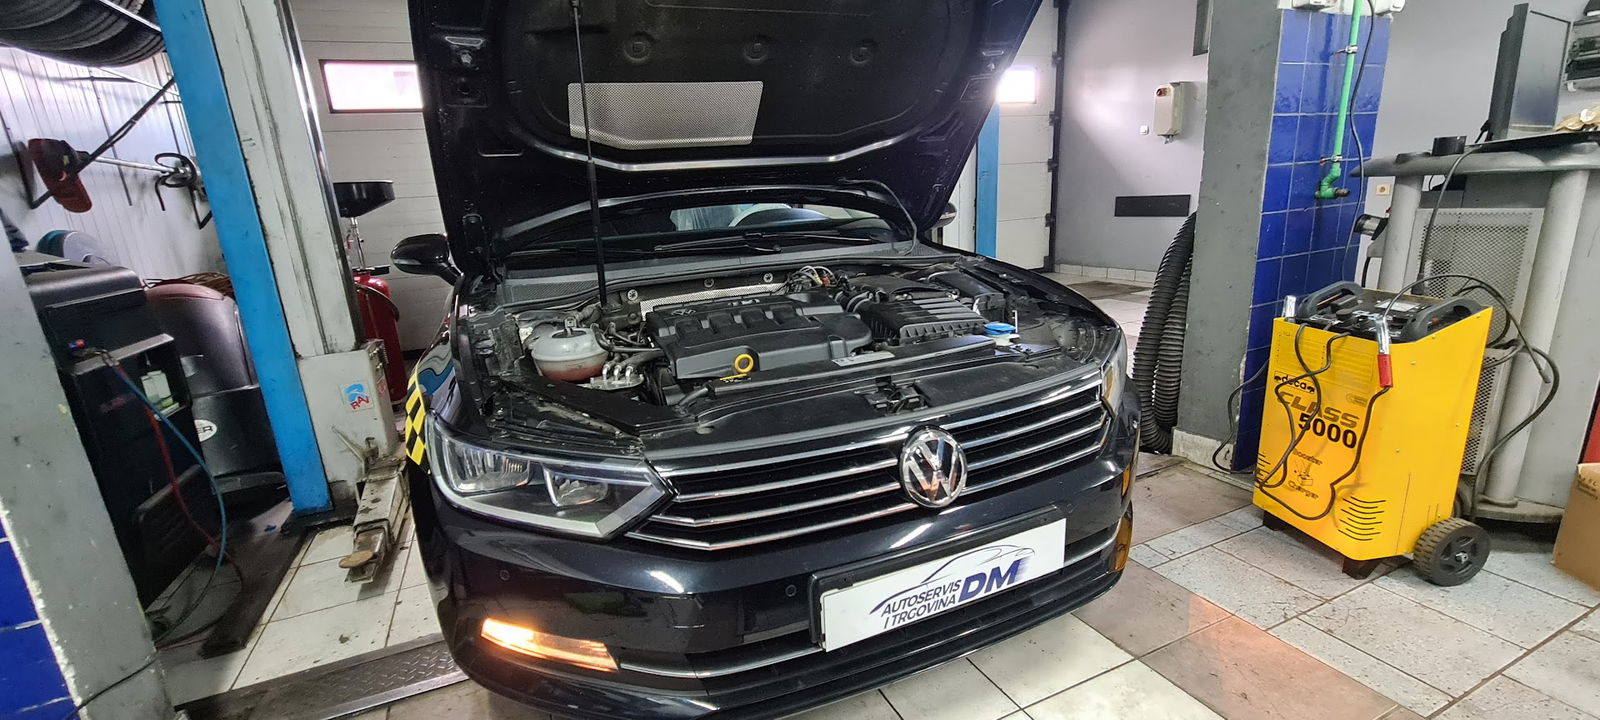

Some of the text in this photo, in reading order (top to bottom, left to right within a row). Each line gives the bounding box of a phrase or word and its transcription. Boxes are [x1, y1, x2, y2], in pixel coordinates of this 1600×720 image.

[1278, 391, 1360, 429] CLASS
[1297, 412, 1358, 449] 5000
[880, 559, 1024, 617] AUTOSERVIS DM
[883, 594, 957, 630] I TRGOVINA
